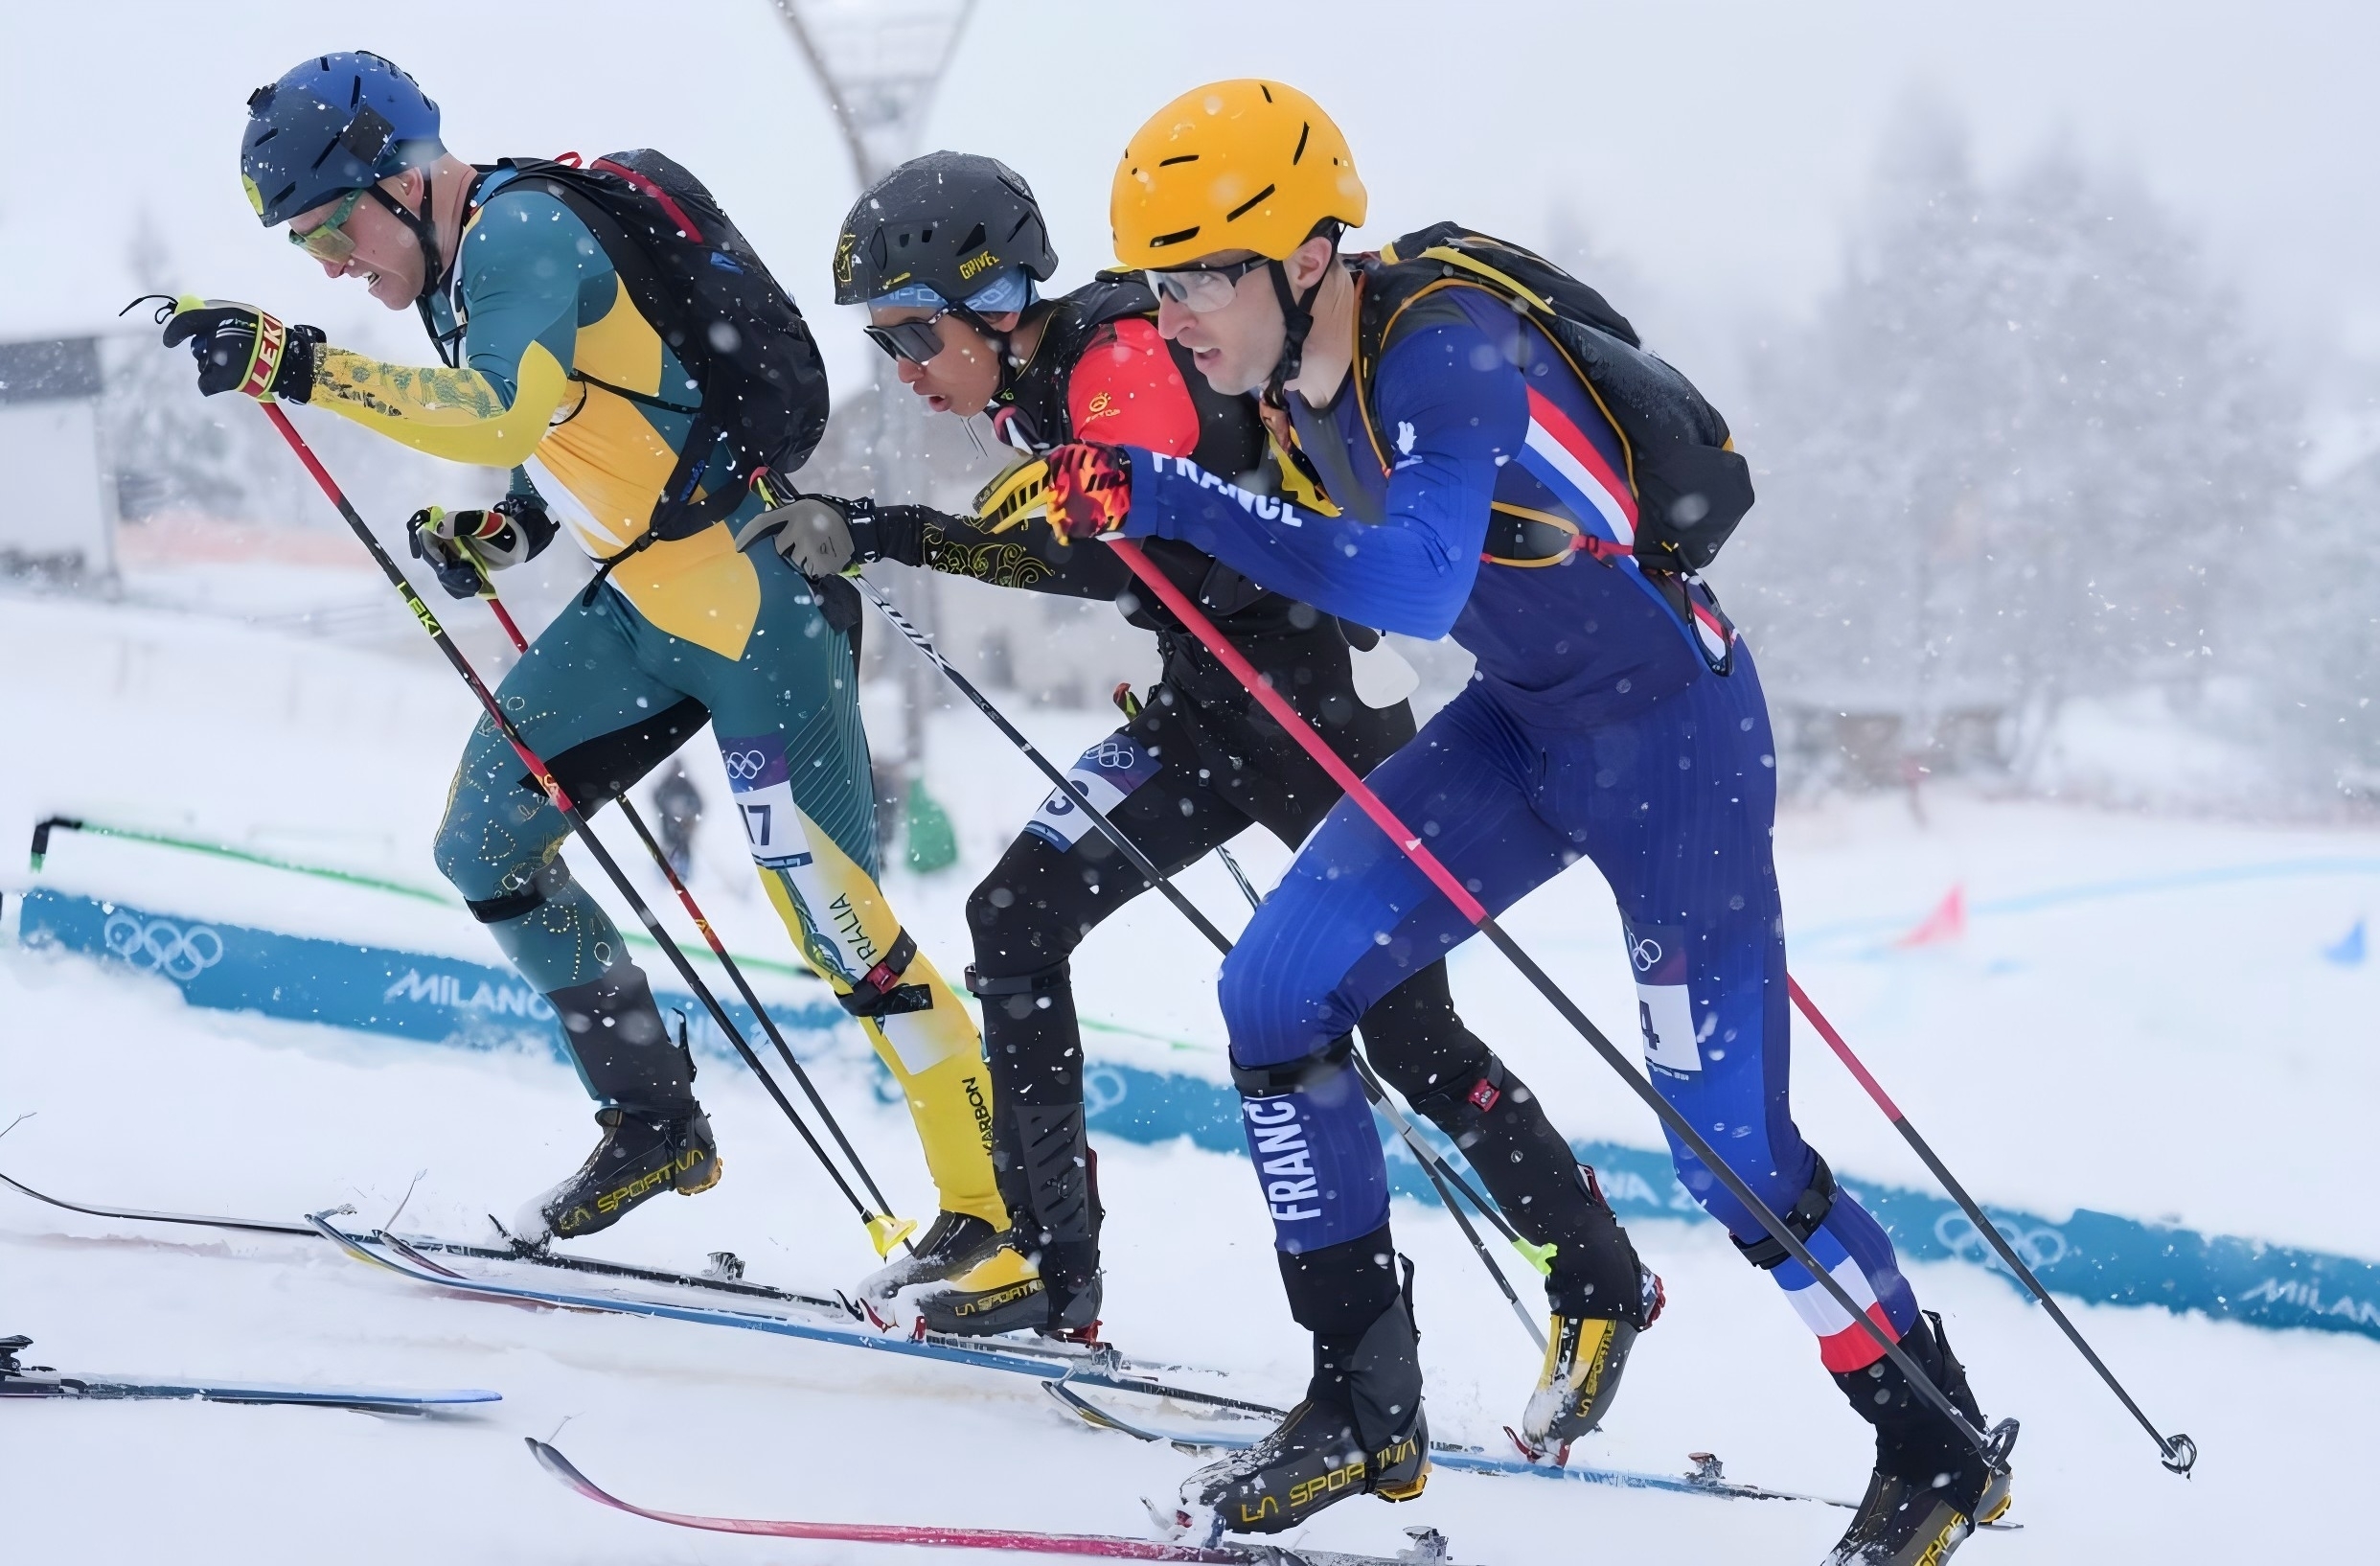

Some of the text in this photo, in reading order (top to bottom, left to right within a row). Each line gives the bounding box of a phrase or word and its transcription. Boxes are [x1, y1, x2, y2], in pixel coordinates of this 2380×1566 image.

[396, 581, 443, 638] LEKI
[830, 892, 878, 970] RALIA
[384, 968, 556, 1022] MILANO
[597, 1150, 704, 1214] SPORTVA
[1244, 1094, 1321, 1221] FRANC
[1242, 1495, 1279, 1522] LA
